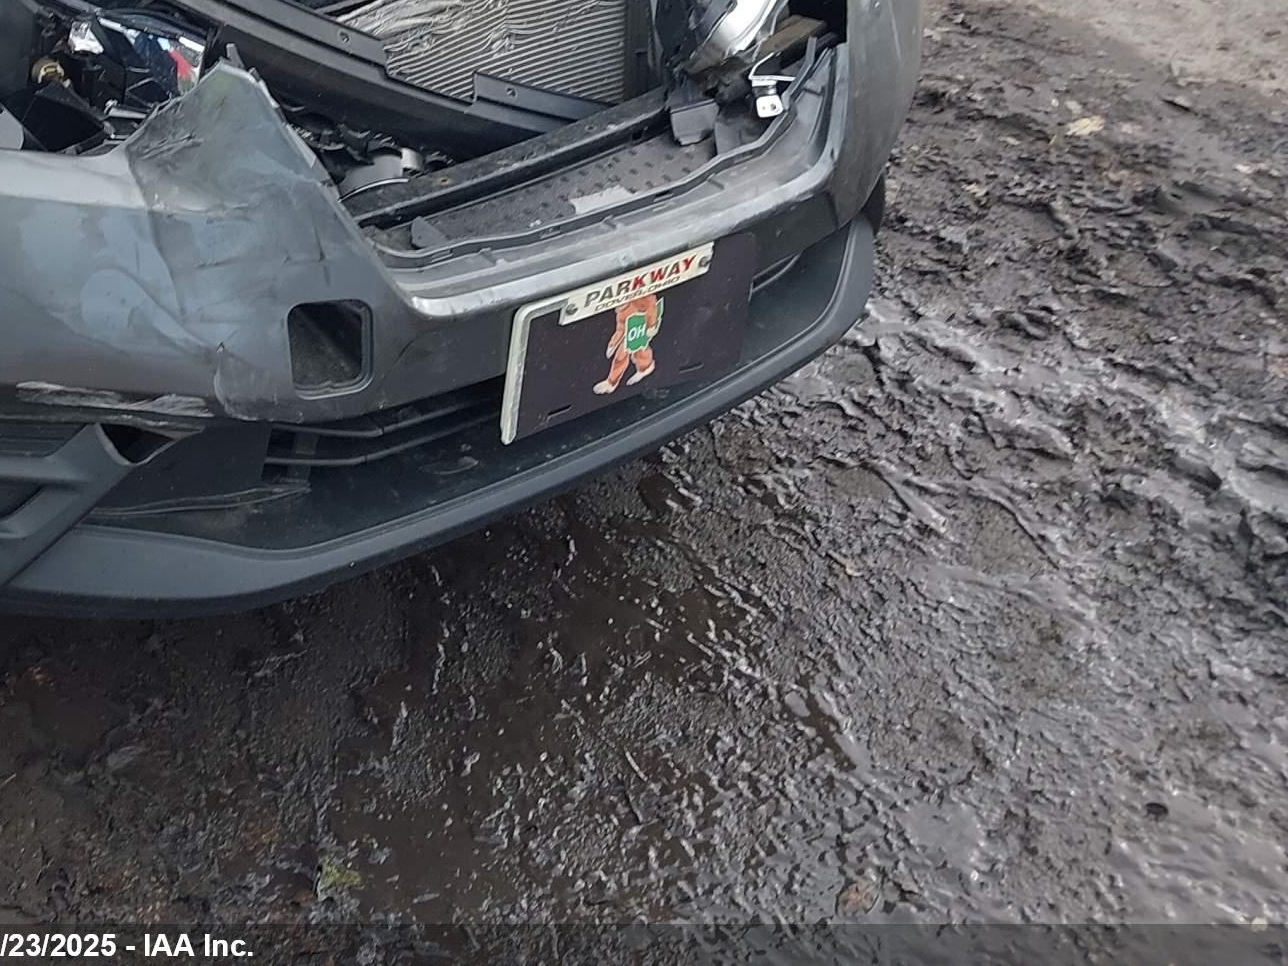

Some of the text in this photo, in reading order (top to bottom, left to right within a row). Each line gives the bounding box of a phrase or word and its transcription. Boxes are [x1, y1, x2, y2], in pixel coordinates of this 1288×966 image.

[584, 254, 697, 308] PARKWAY
[648, 276, 681, 293] OHIO
[627, 323, 647, 342] OH
